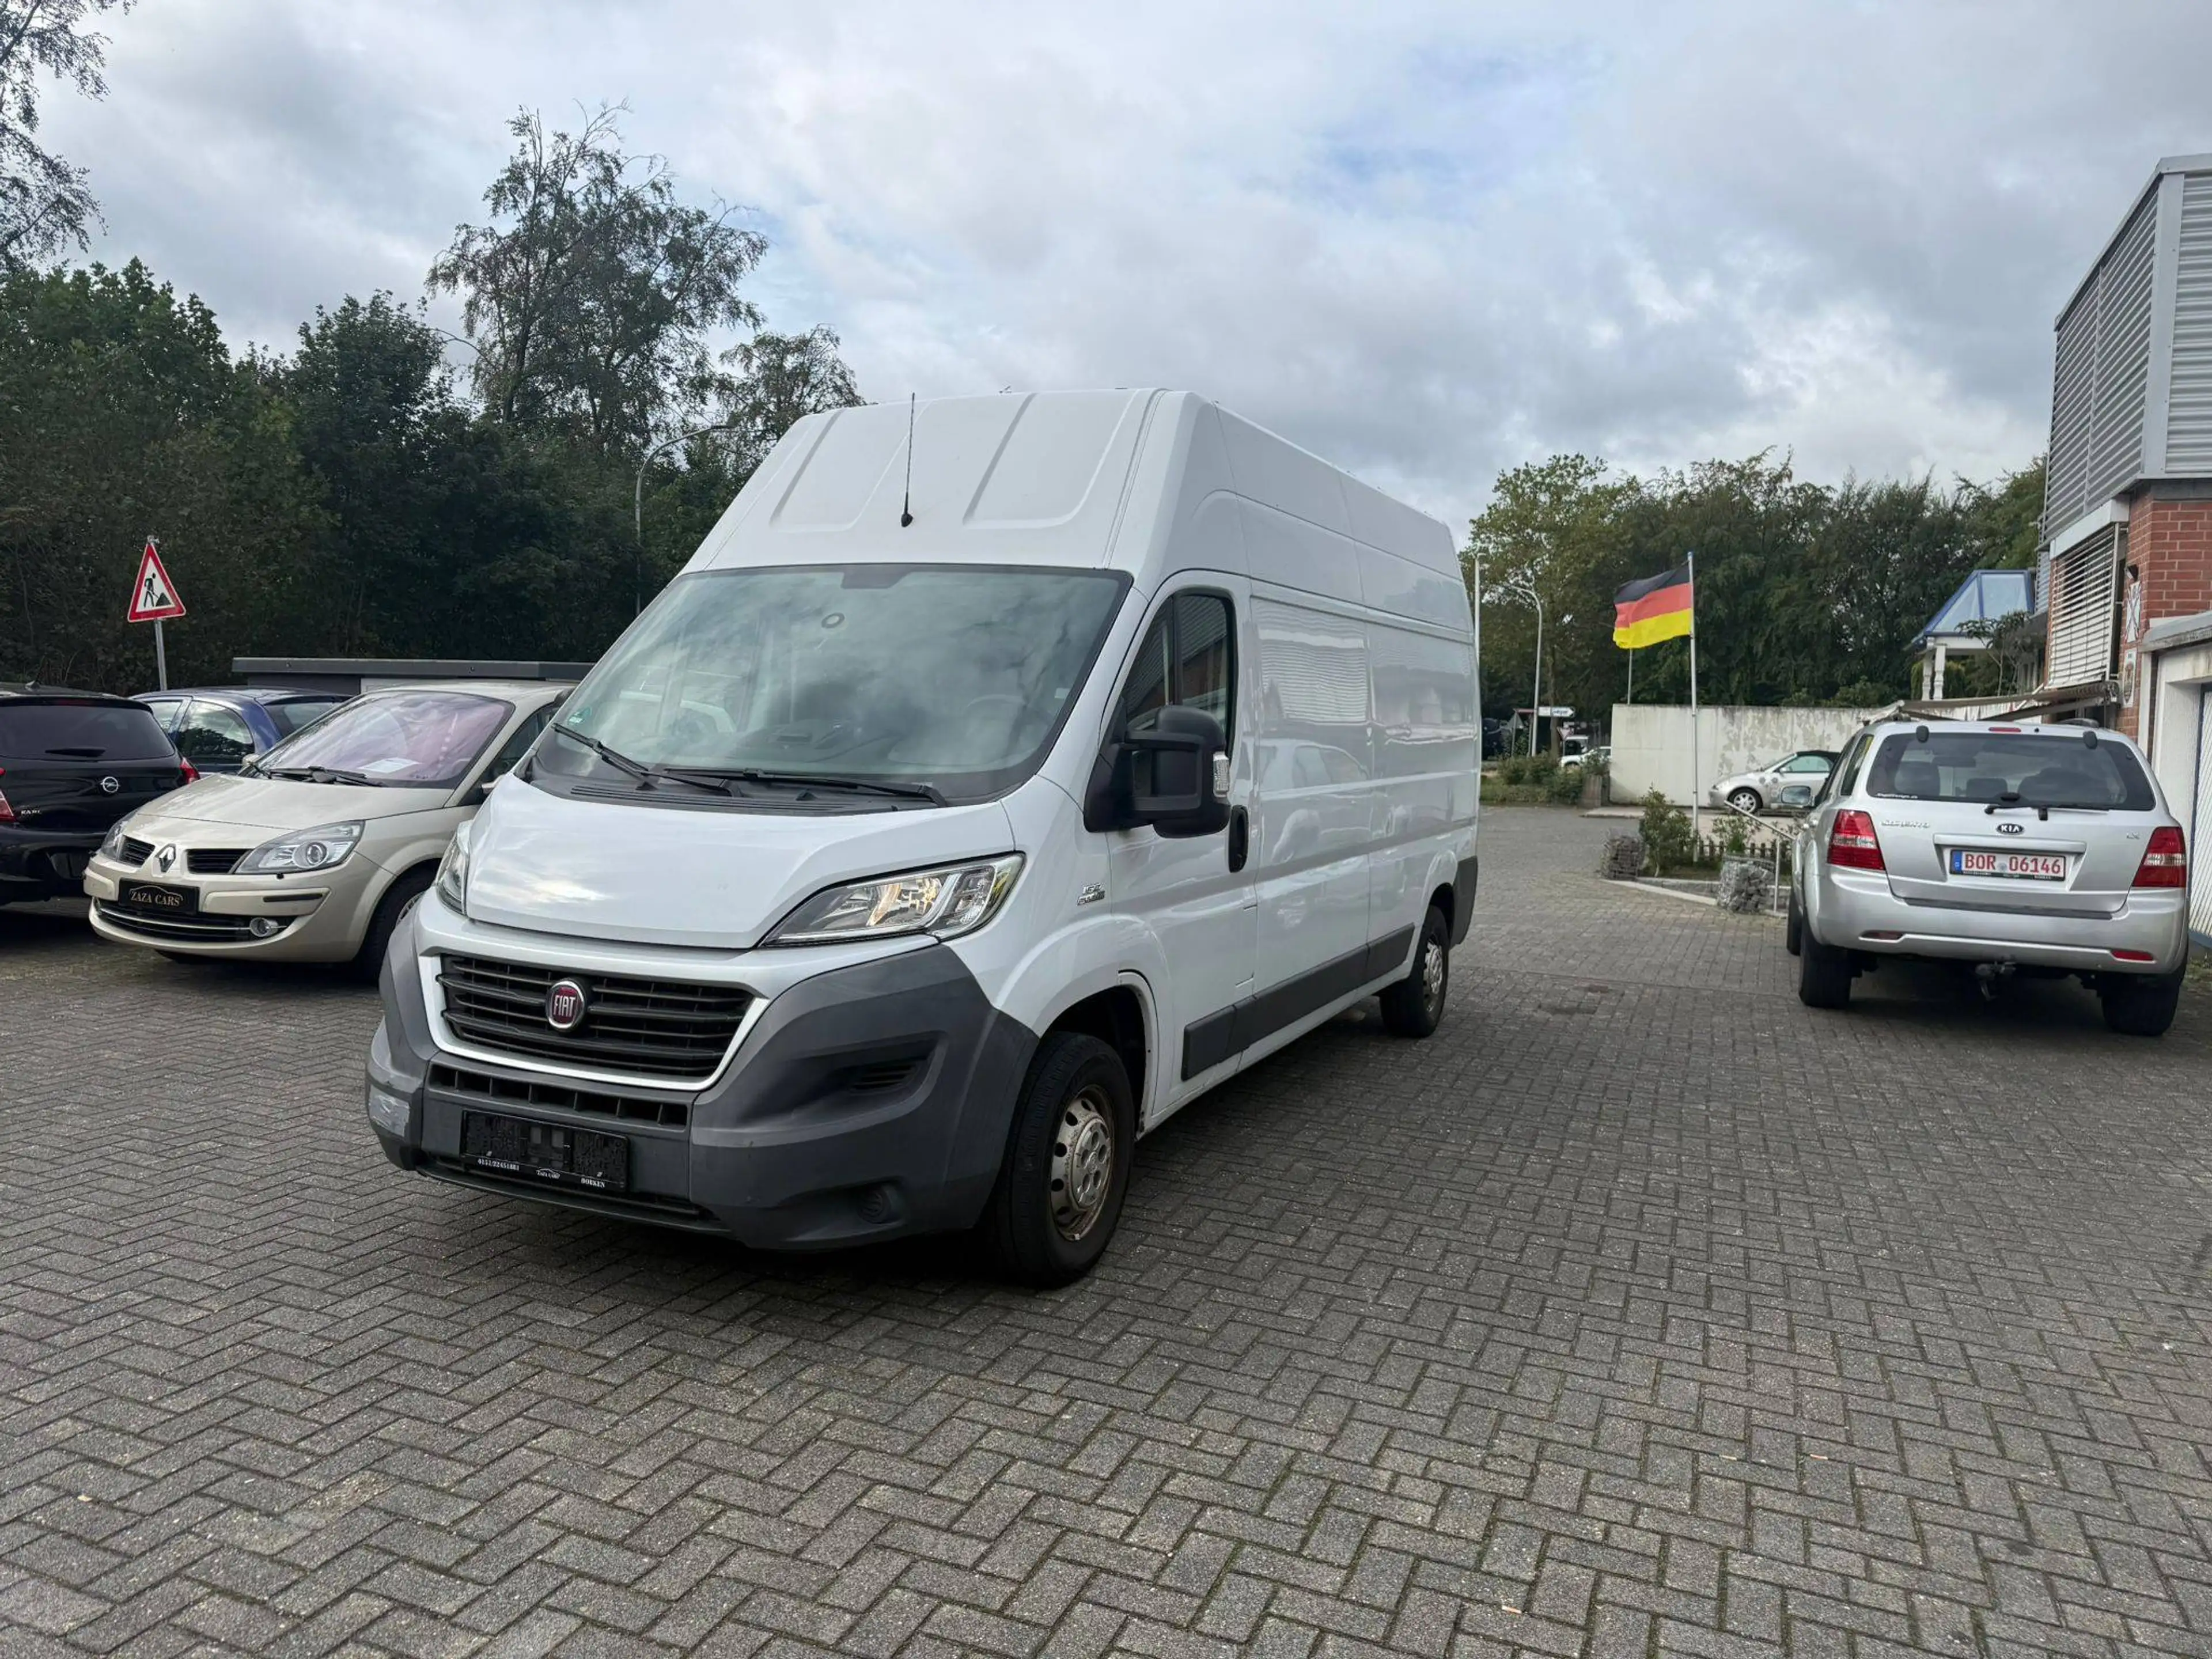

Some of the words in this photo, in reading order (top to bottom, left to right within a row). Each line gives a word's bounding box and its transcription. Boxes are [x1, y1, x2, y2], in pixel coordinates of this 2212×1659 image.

[1965, 853, 1996, 870] BOR
[2009, 855, 2061, 874] 06146
[131, 891, 151, 903] ZAZA
[155, 893, 180, 906] CARS
[554, 995, 575, 1017] FIAT
